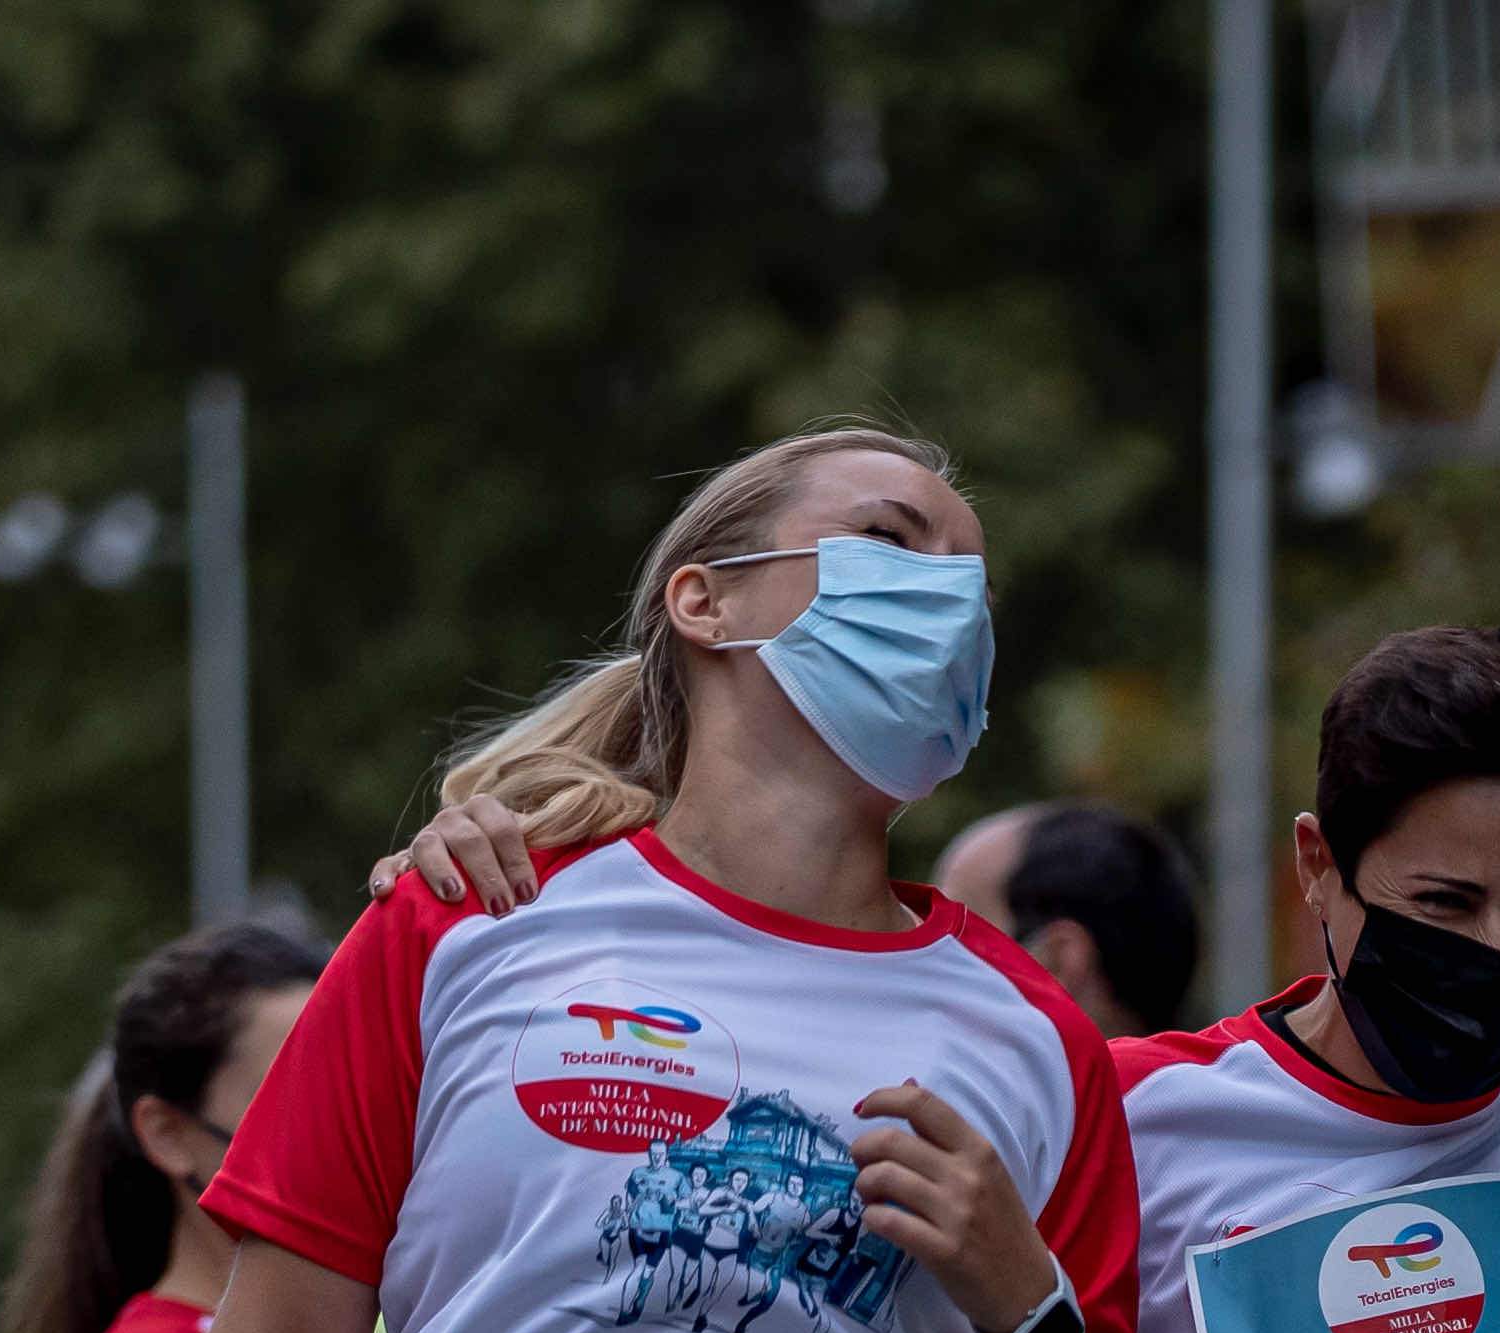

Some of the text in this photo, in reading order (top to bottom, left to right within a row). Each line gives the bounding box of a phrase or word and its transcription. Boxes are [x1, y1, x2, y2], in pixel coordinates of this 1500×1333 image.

[561, 1051, 695, 1076] TotalEnergies
[590, 1083, 650, 1103] MILLA
[561, 1118, 671, 1141] DE MADRID
[1358, 1277, 1456, 1307] TotalEnergies
[1389, 1310, 1436, 1330] MILLA
